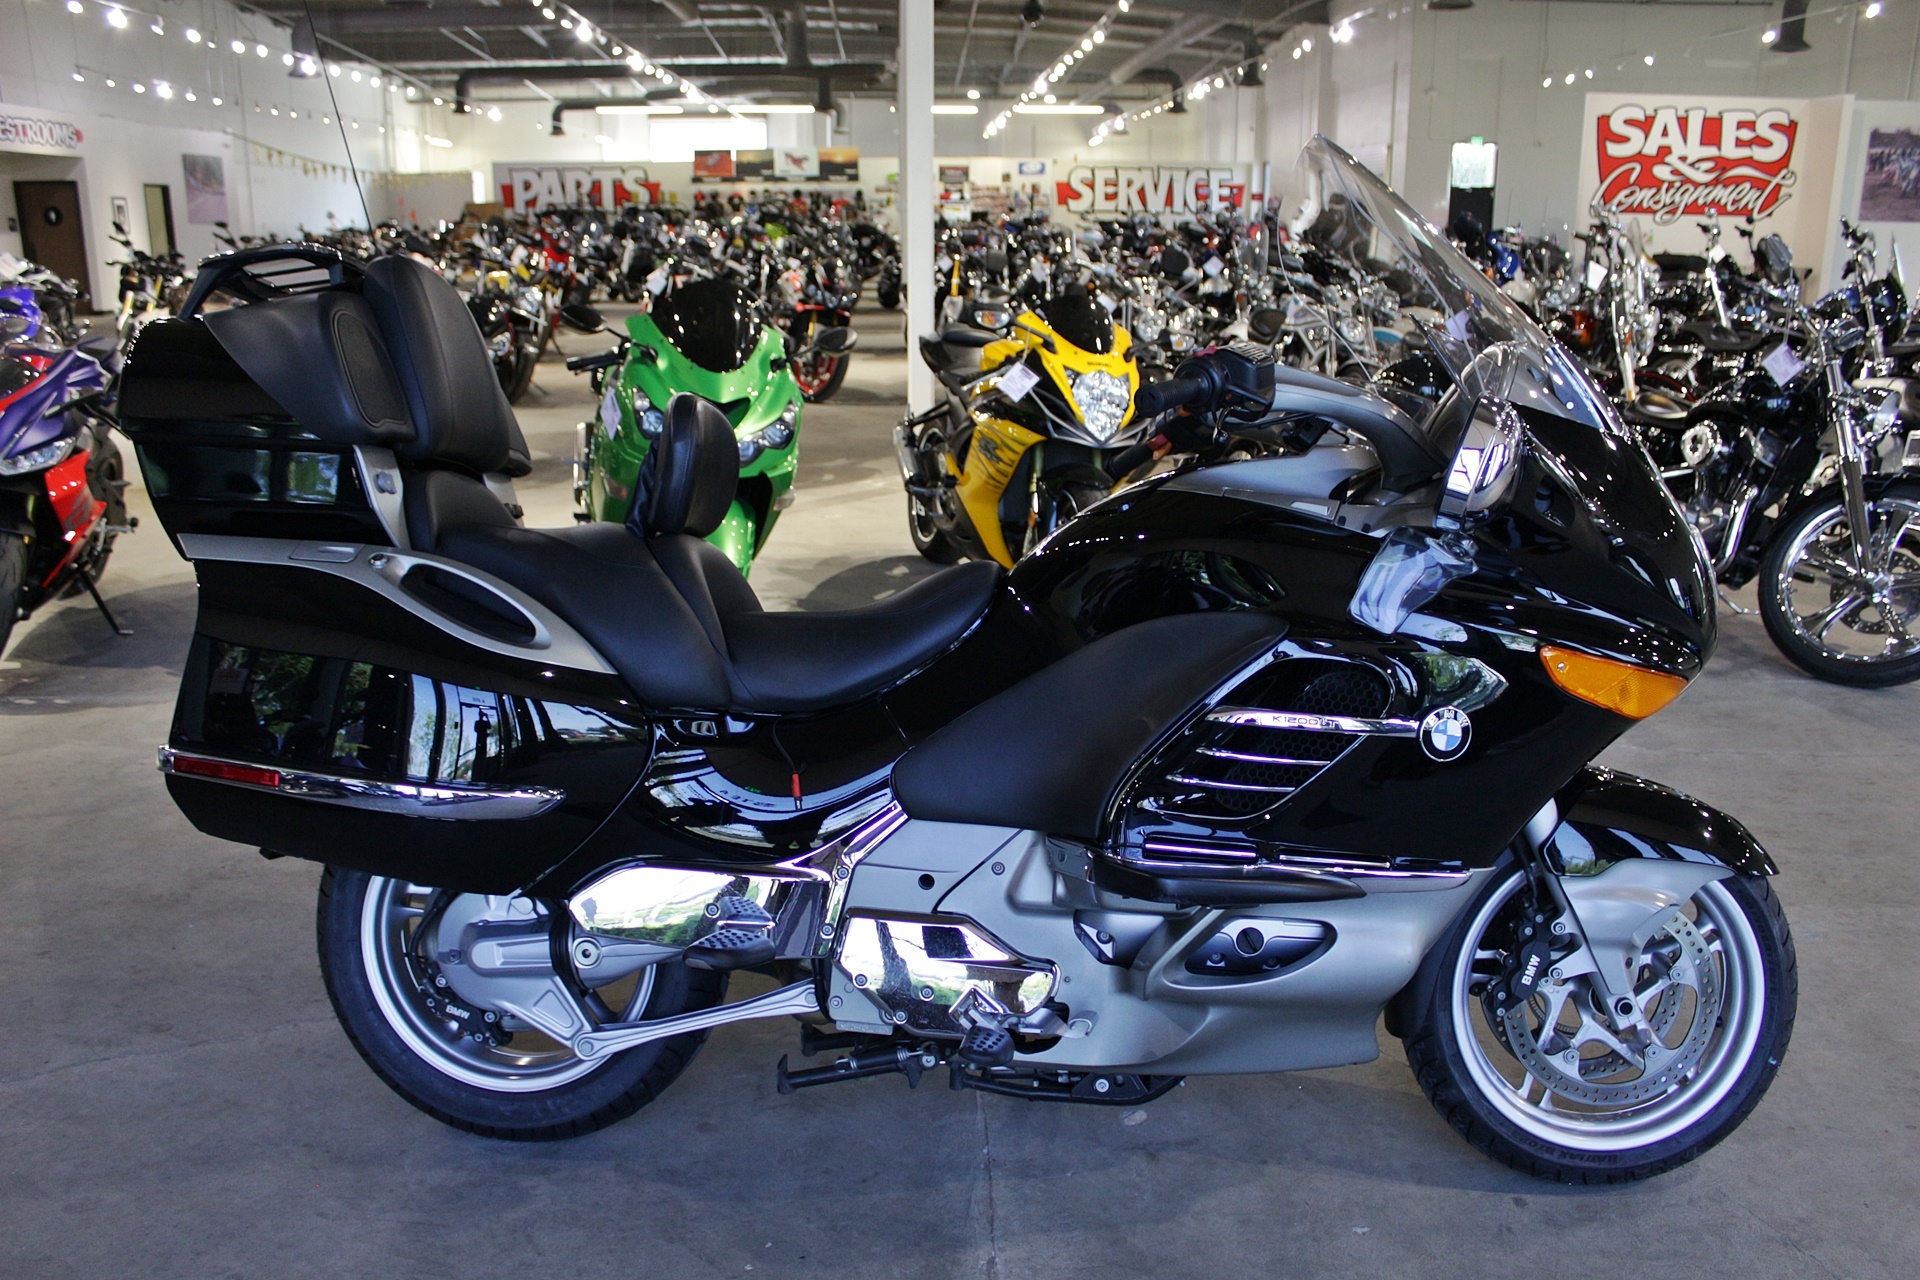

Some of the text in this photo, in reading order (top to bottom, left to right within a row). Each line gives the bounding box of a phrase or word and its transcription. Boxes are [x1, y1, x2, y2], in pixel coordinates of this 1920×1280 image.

[1605, 104, 1790, 163] SALES
[509, 166, 650, 214] PARTS
[1067, 166, 1234, 214] SERVICE
[1592, 161, 1797, 226] Consignment
[1521, 954, 1541, 986] BMW
[445, 1004, 471, 1020] BMW
